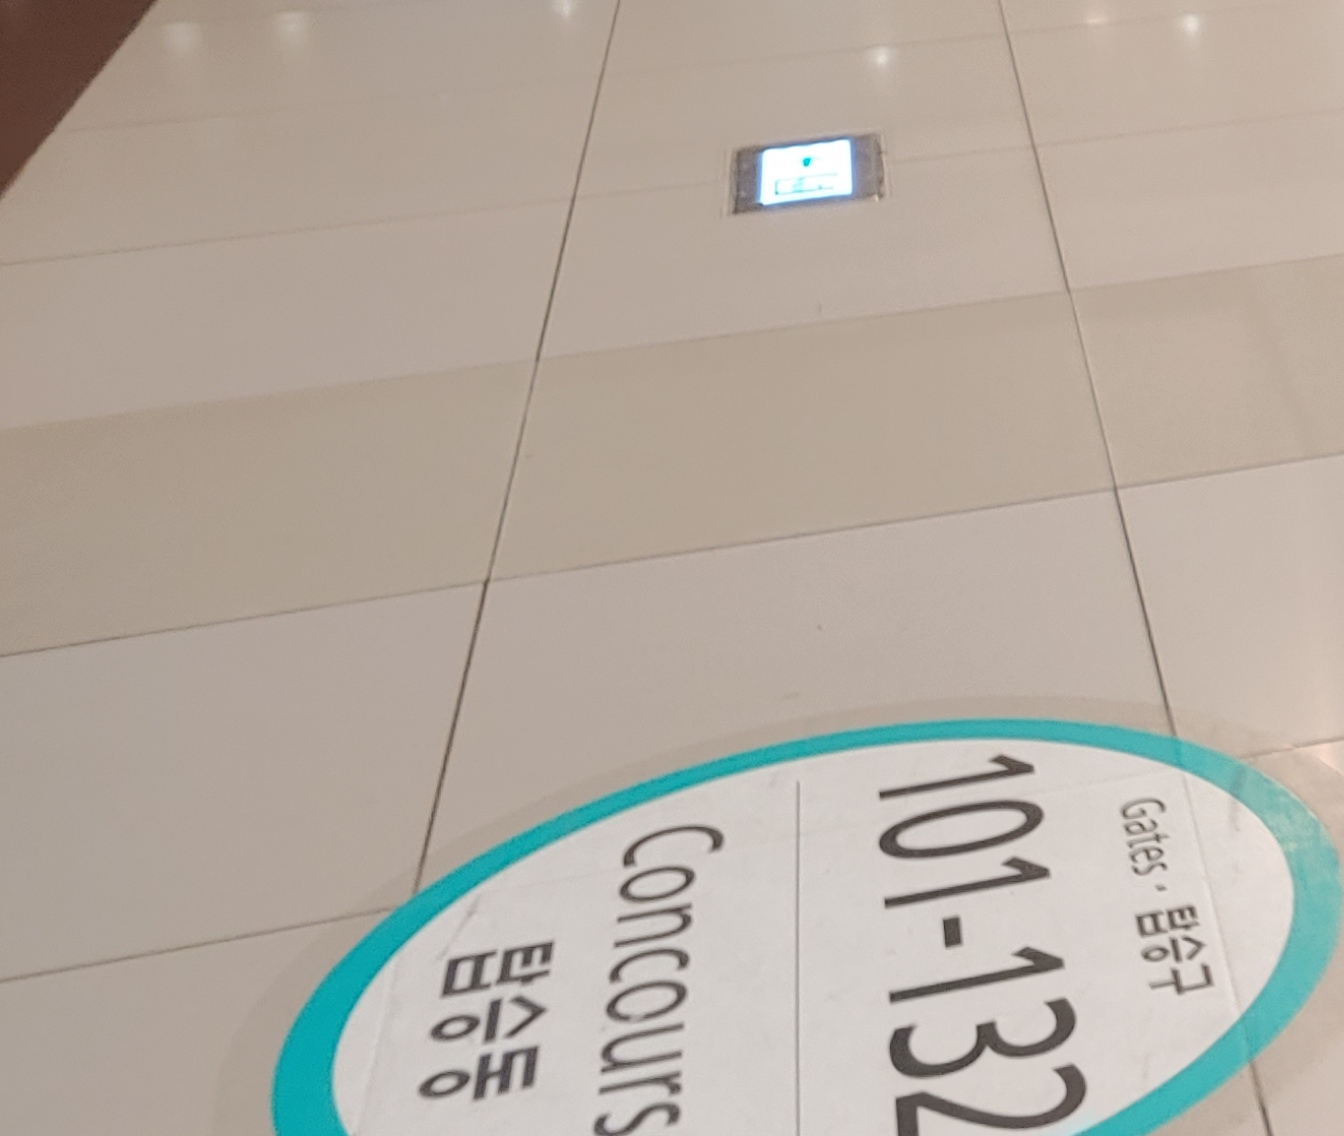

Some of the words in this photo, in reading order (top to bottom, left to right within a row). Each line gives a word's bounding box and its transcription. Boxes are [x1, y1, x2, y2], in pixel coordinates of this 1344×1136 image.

[1119, 797, 1168, 877] Gates
[878, 755, 1087, 1136] 101-132
[1134, 904, 1215, 996] 탑승구
[417, 940, 555, 1102] 탑승동
